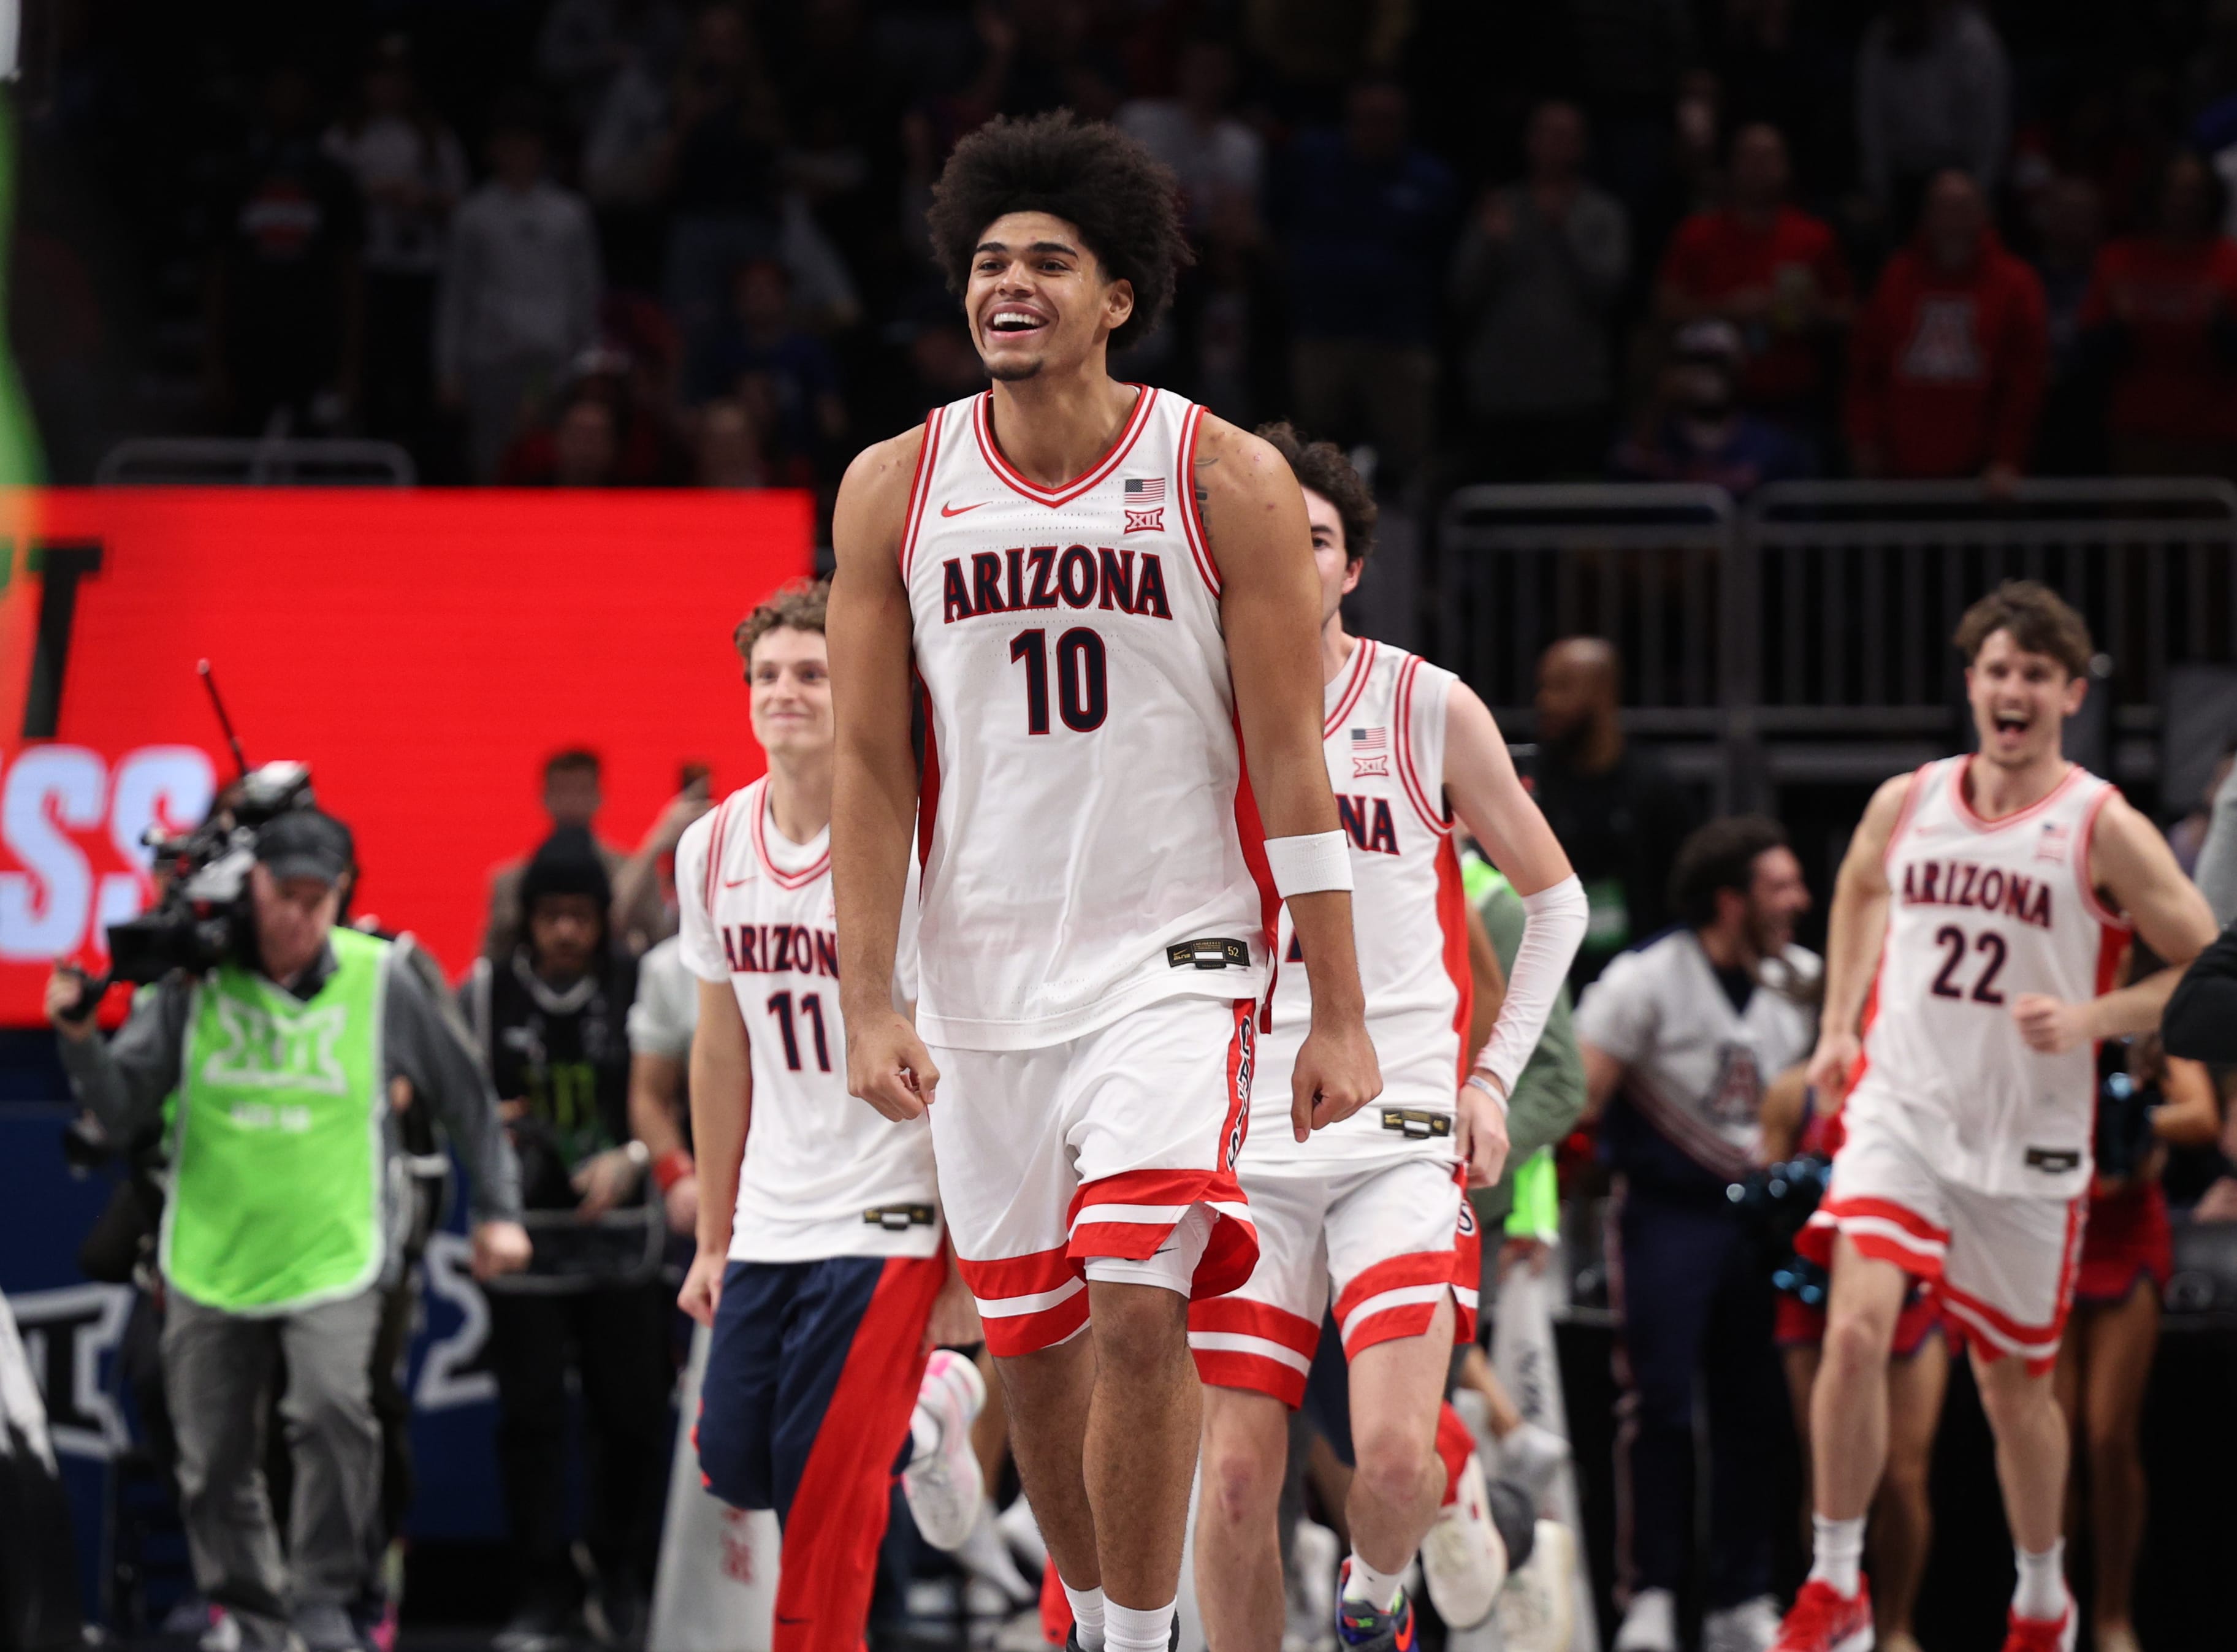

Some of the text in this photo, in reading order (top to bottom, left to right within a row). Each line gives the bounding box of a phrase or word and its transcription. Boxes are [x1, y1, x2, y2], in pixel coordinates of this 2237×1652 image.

[943, 544, 1173, 624] ARIZONA
[1010, 626, 1108, 736] 10
[1902, 861, 2052, 929] ARIZONA
[723, 922, 840, 980] ARIZON
[1227, 945, 1239, 957] 52
[1930, 926, 2006, 1005] 22
[767, 990, 831, 1072] 11
